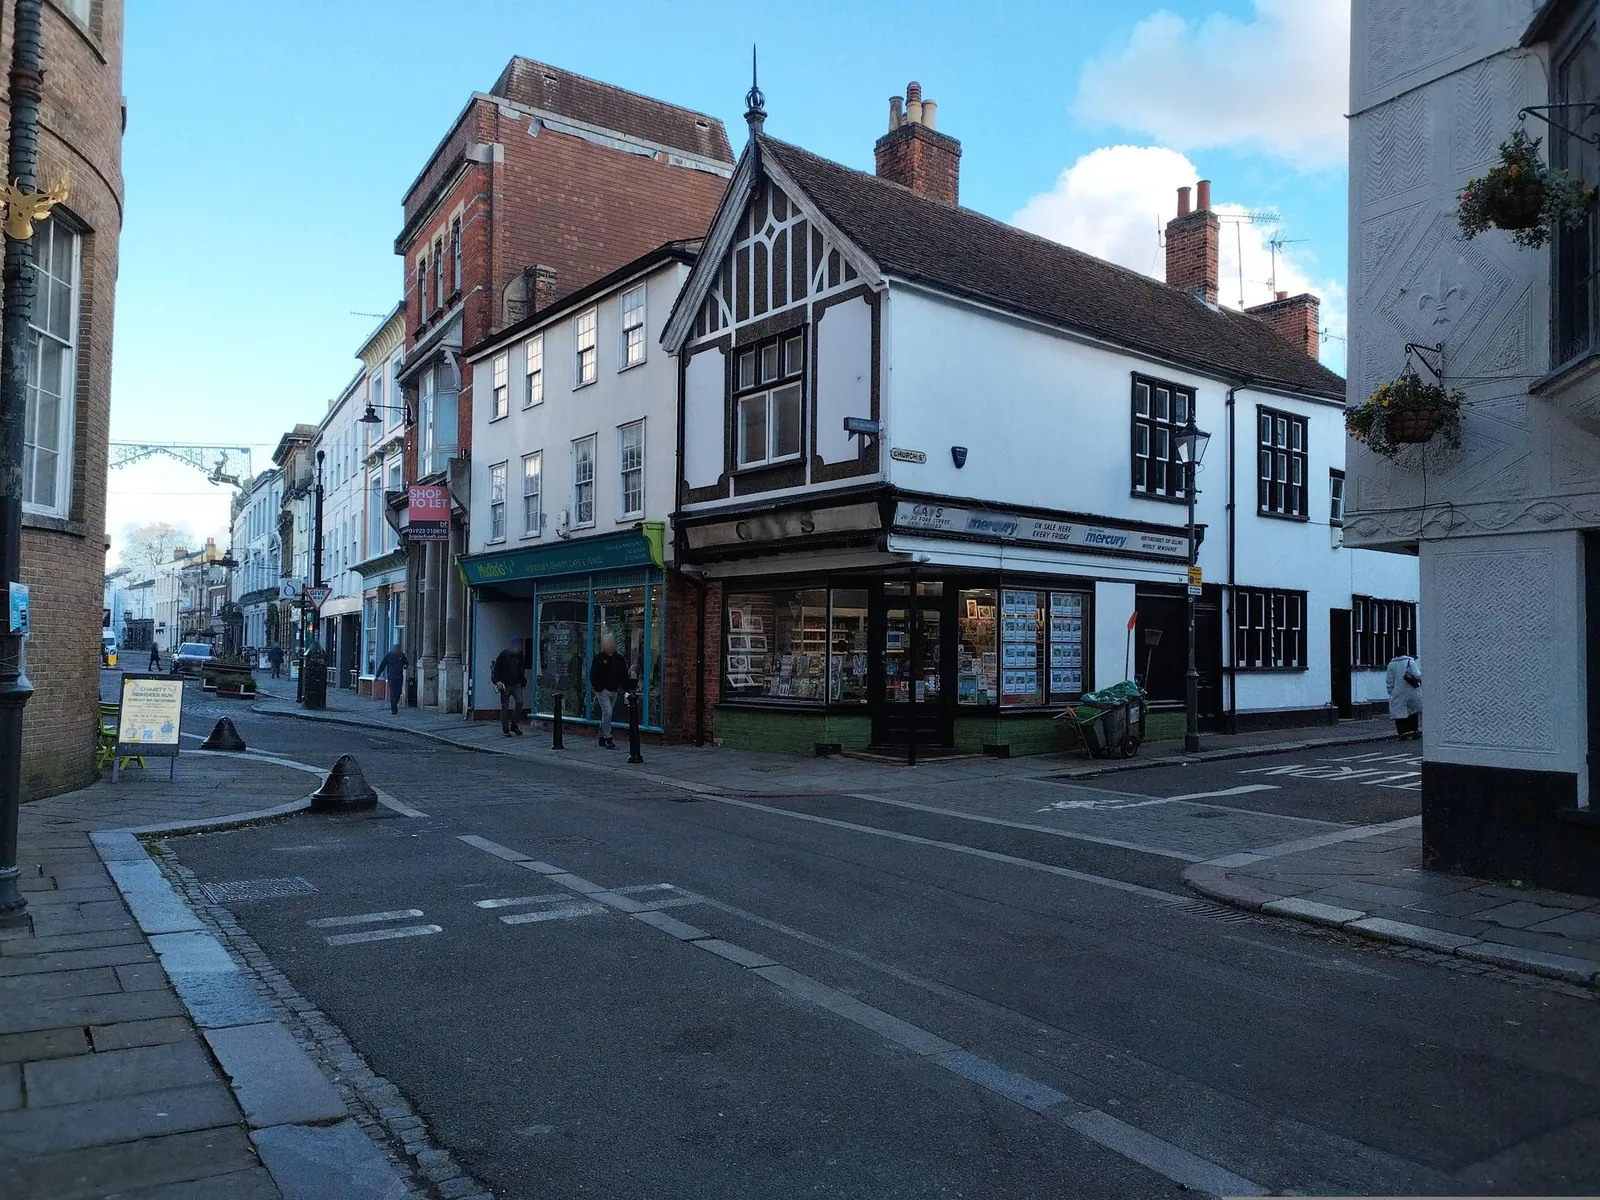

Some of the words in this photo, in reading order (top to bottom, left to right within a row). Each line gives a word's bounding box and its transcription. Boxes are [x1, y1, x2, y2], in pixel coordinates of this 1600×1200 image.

[894, 450, 918, 460] CHURCH
[410, 489, 442, 498] SHOP
[410, 498, 425, 508] TO
[430, 499, 447, 508] LET
[1044, 523, 1056, 531] SALE
[1058, 524, 1072, 533] HERE
[1032, 530, 1050, 538] EVERY
[1052, 532, 1070, 540] FRIDAY
[1085, 532, 1127, 547] mercury
